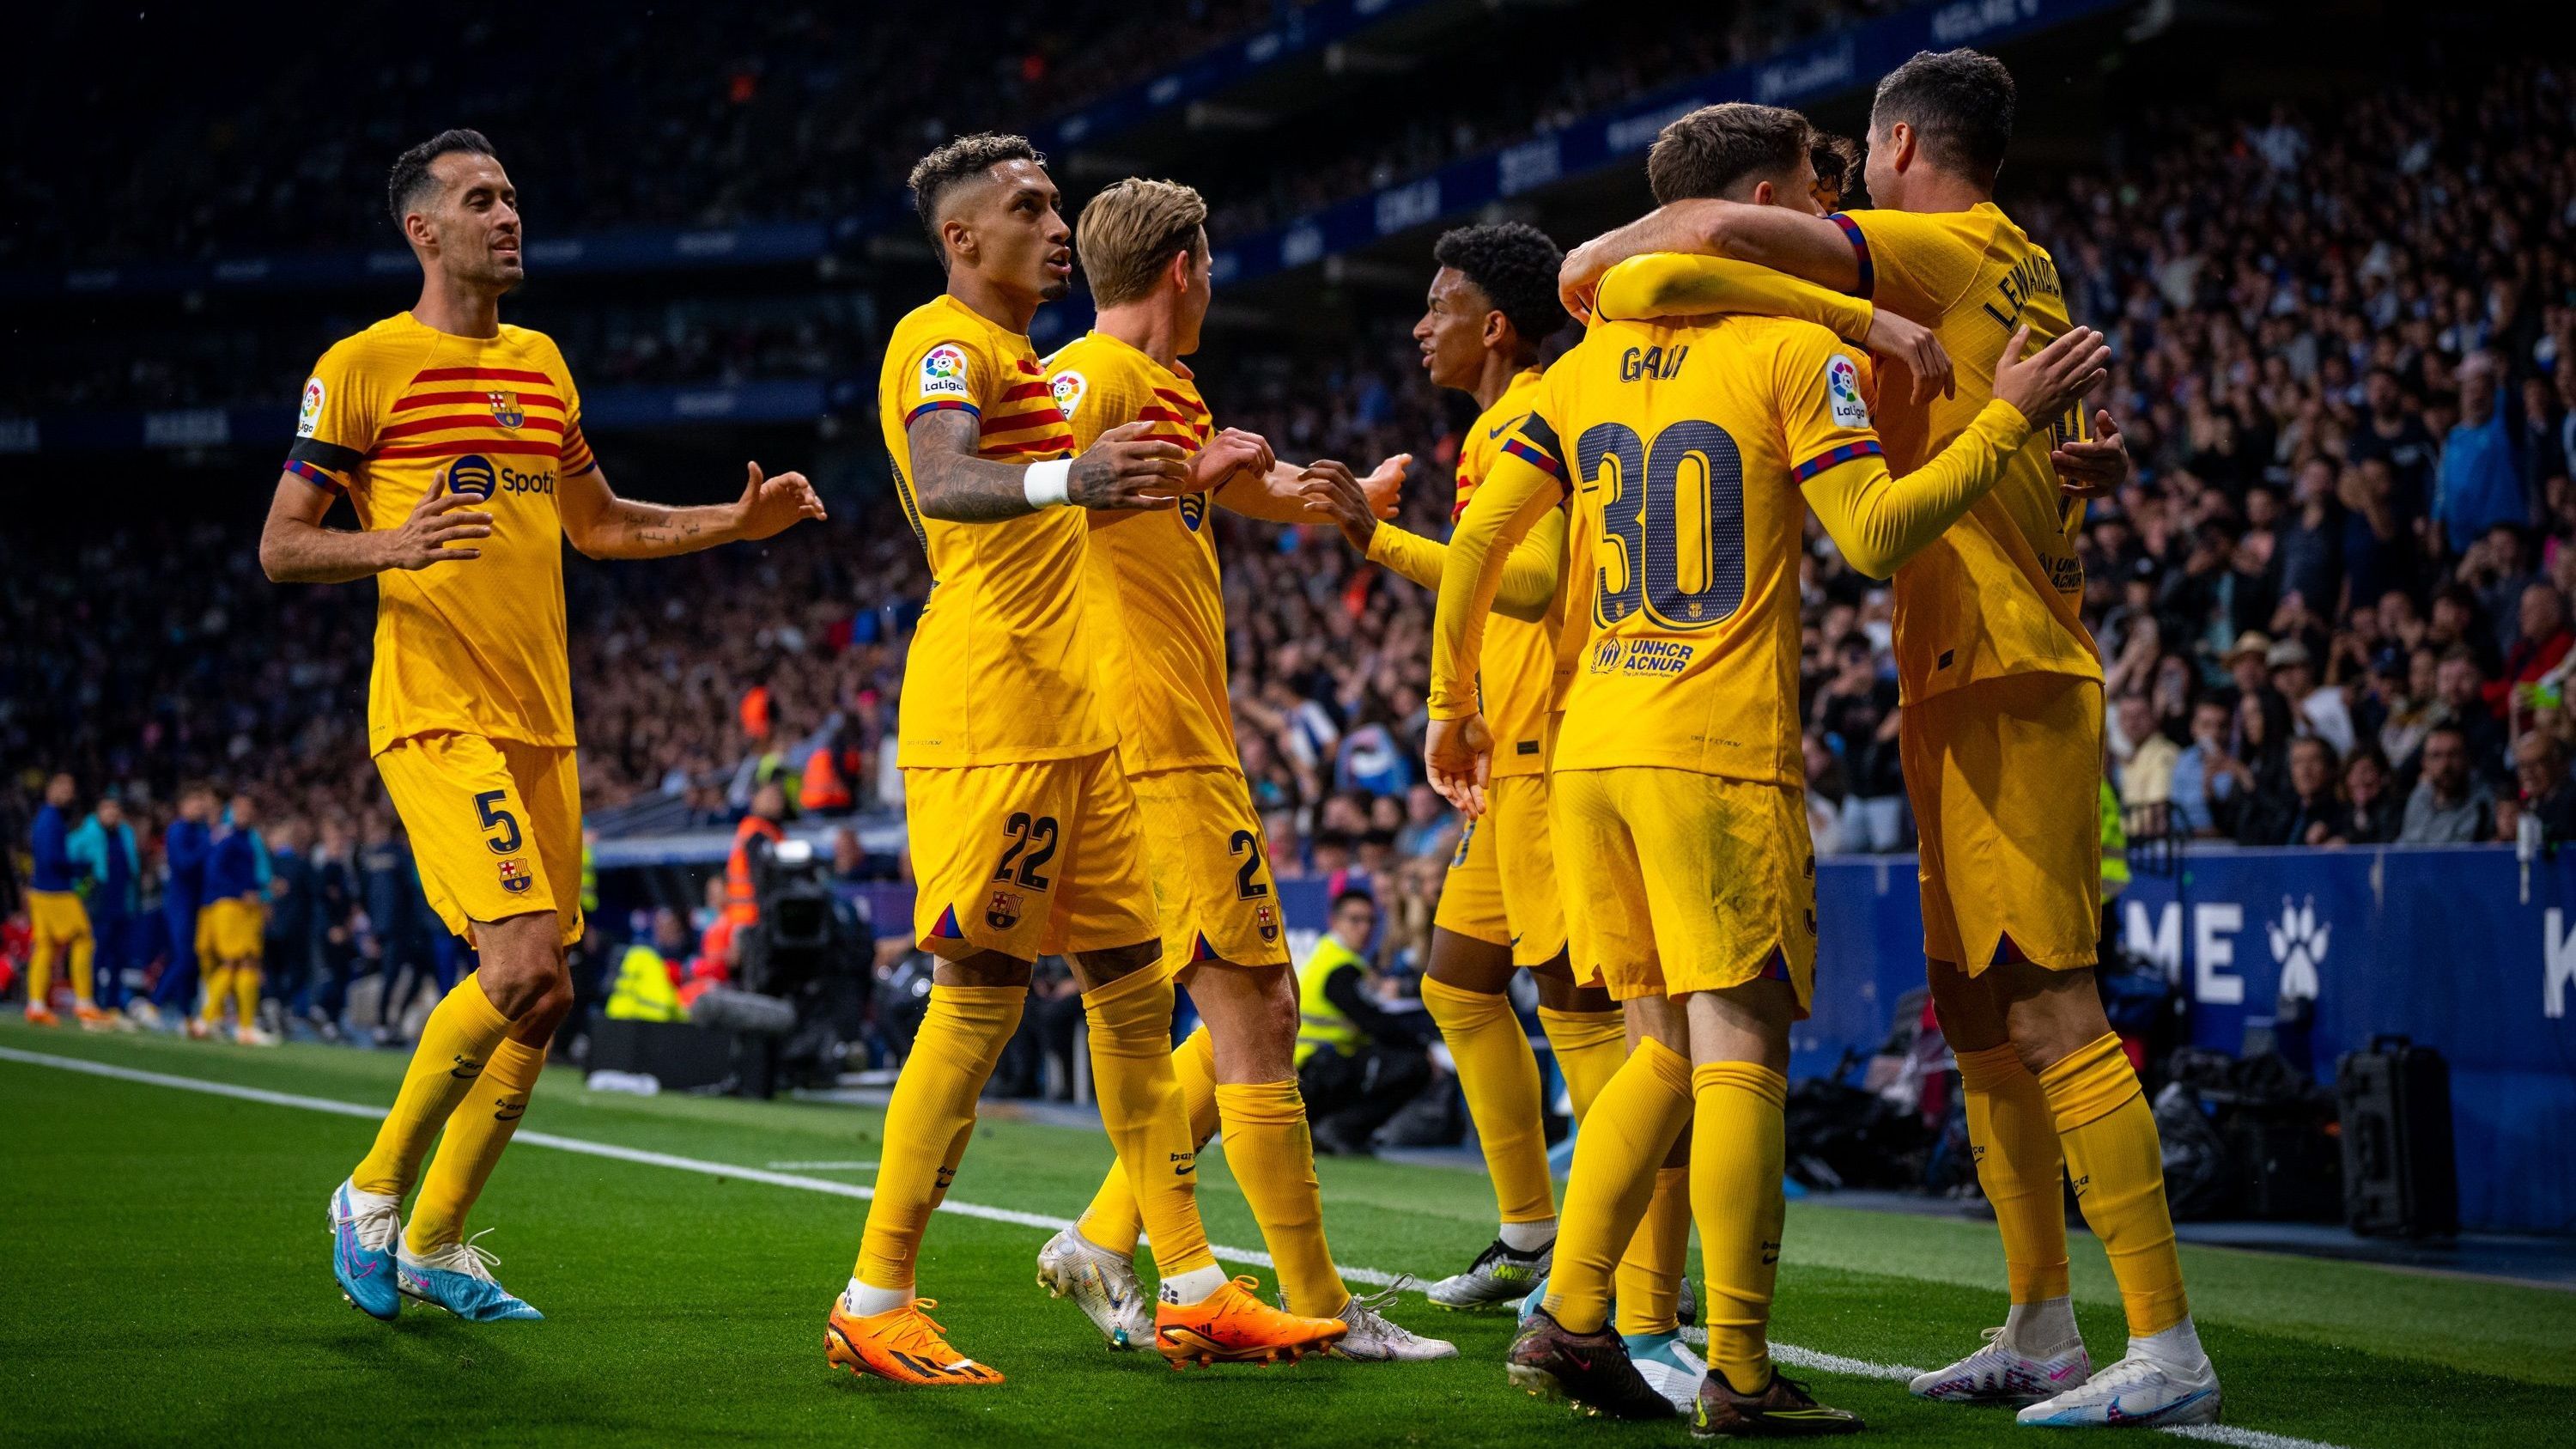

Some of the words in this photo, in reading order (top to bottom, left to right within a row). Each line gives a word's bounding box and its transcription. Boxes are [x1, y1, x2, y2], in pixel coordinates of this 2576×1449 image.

[925, 380, 964, 392] LaLiga
[1837, 405, 1865, 420] LaLiga
[1575, 419, 1746, 631] 30
[1631, 640, 1693, 661] UNHCR
[1624, 655, 1686, 673] ACNUR
[472, 789, 522, 855] 5
[992, 812, 1058, 893] 22
